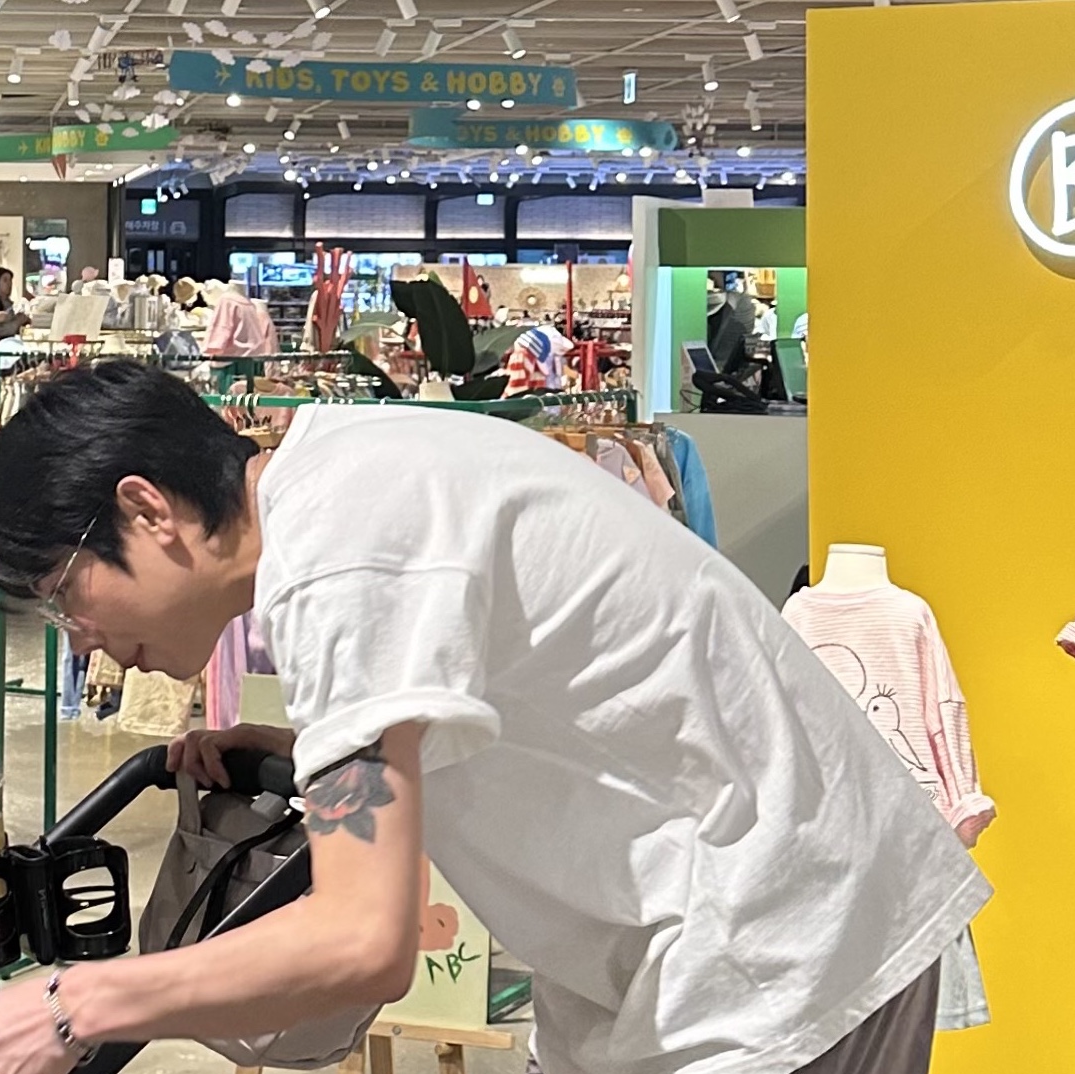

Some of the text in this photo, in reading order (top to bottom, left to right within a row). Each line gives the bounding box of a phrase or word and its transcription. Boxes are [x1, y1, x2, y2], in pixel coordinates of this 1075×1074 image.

[332, 68, 410, 94] TOYS
[421, 71, 438, 92] &
[447, 71, 542, 97] HOBBY
[506, 126, 519, 140] &
[526, 123, 604, 143] HOBBY
[425, 941, 482, 985] ABC
